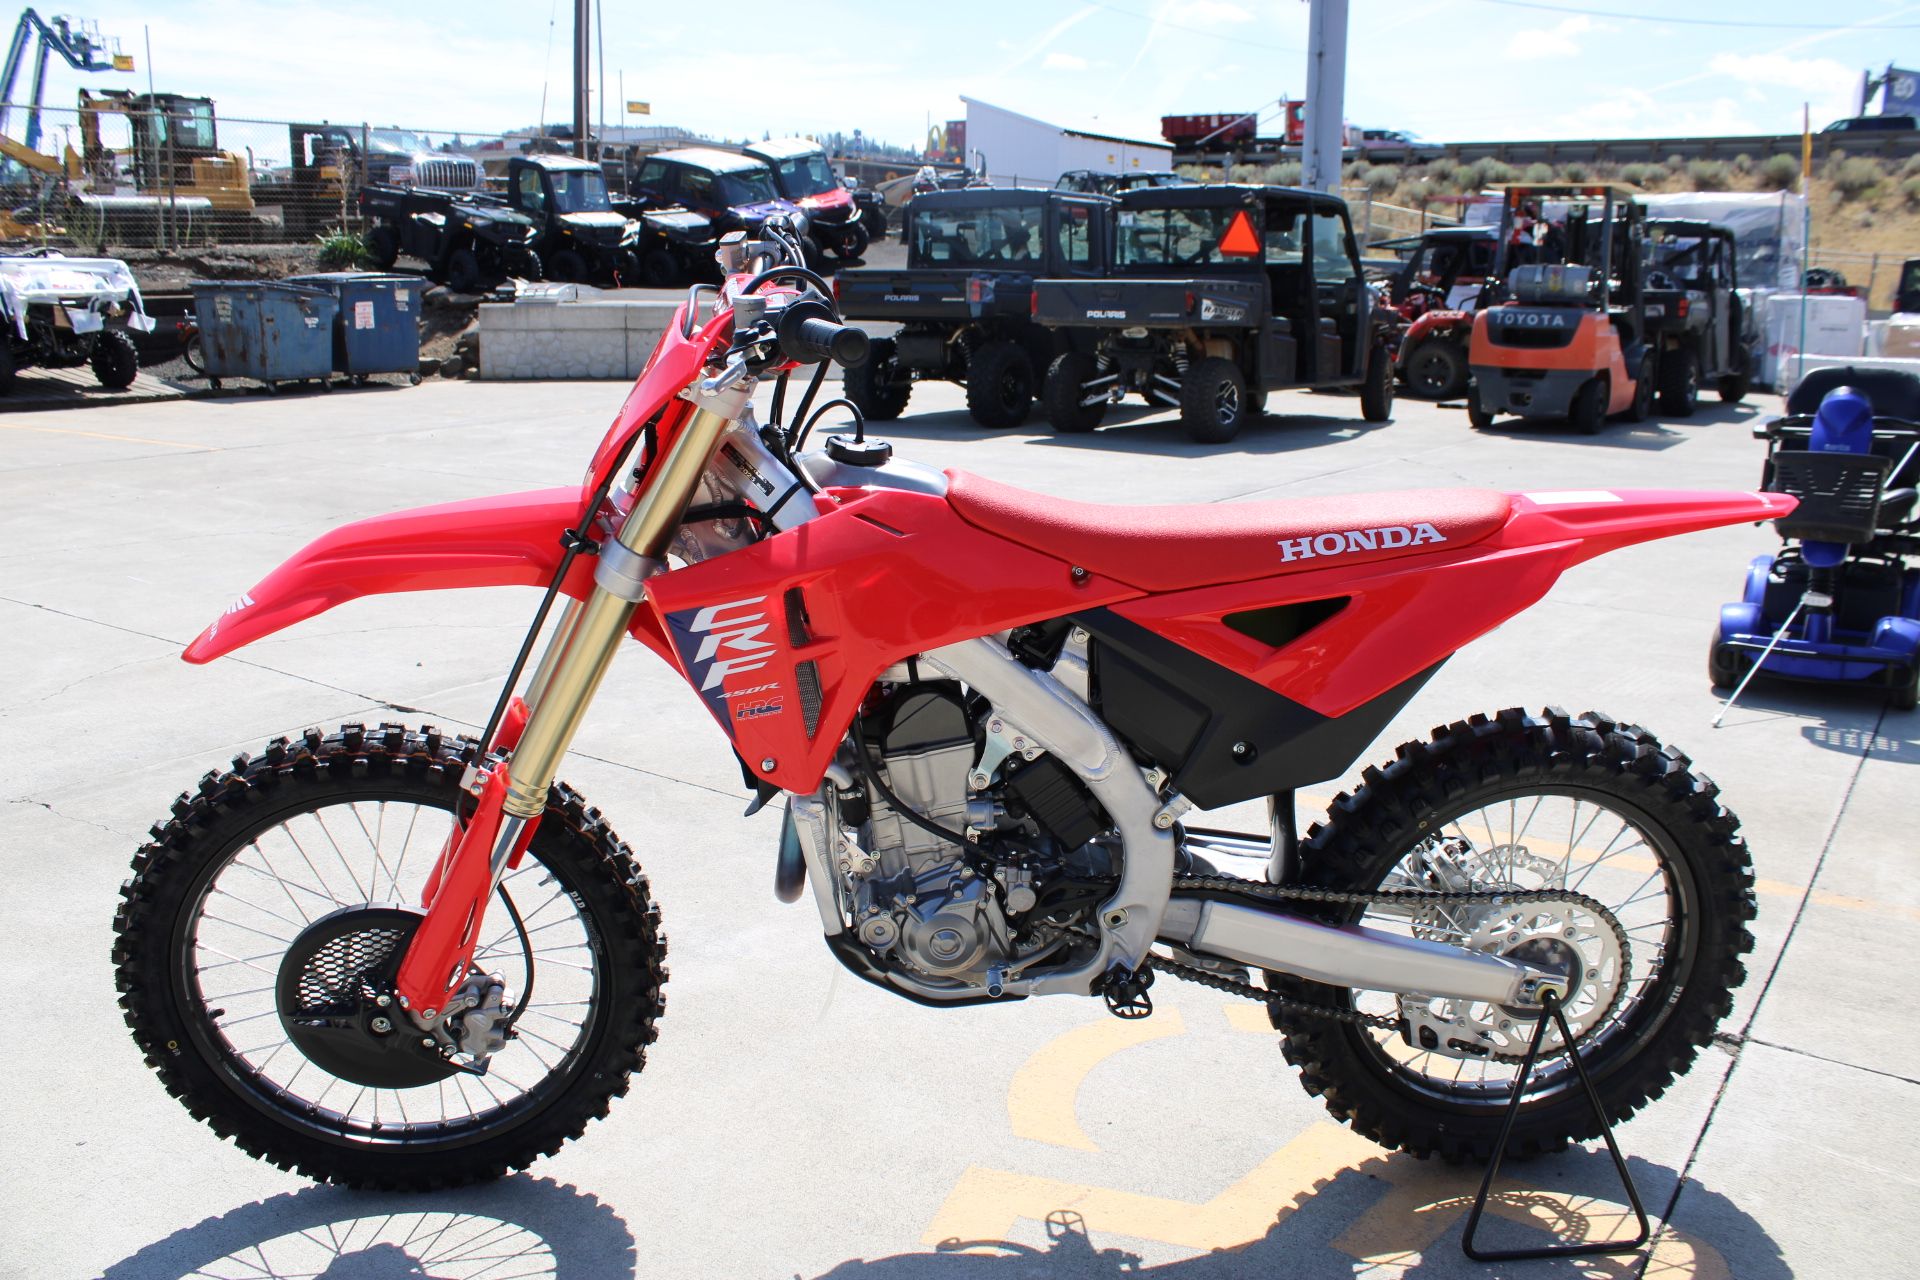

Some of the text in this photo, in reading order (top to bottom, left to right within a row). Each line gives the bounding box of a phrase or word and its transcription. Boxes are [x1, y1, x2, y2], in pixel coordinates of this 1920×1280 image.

[884, 294, 920, 302] POLARIS
[1086, 309, 1127, 319] POLARIS
[1496, 313, 1564, 326] TOYOTA
[1278, 522, 1447, 562] HONDA
[689, 595, 777, 691] CRF
[736, 695, 784, 719] HRC
